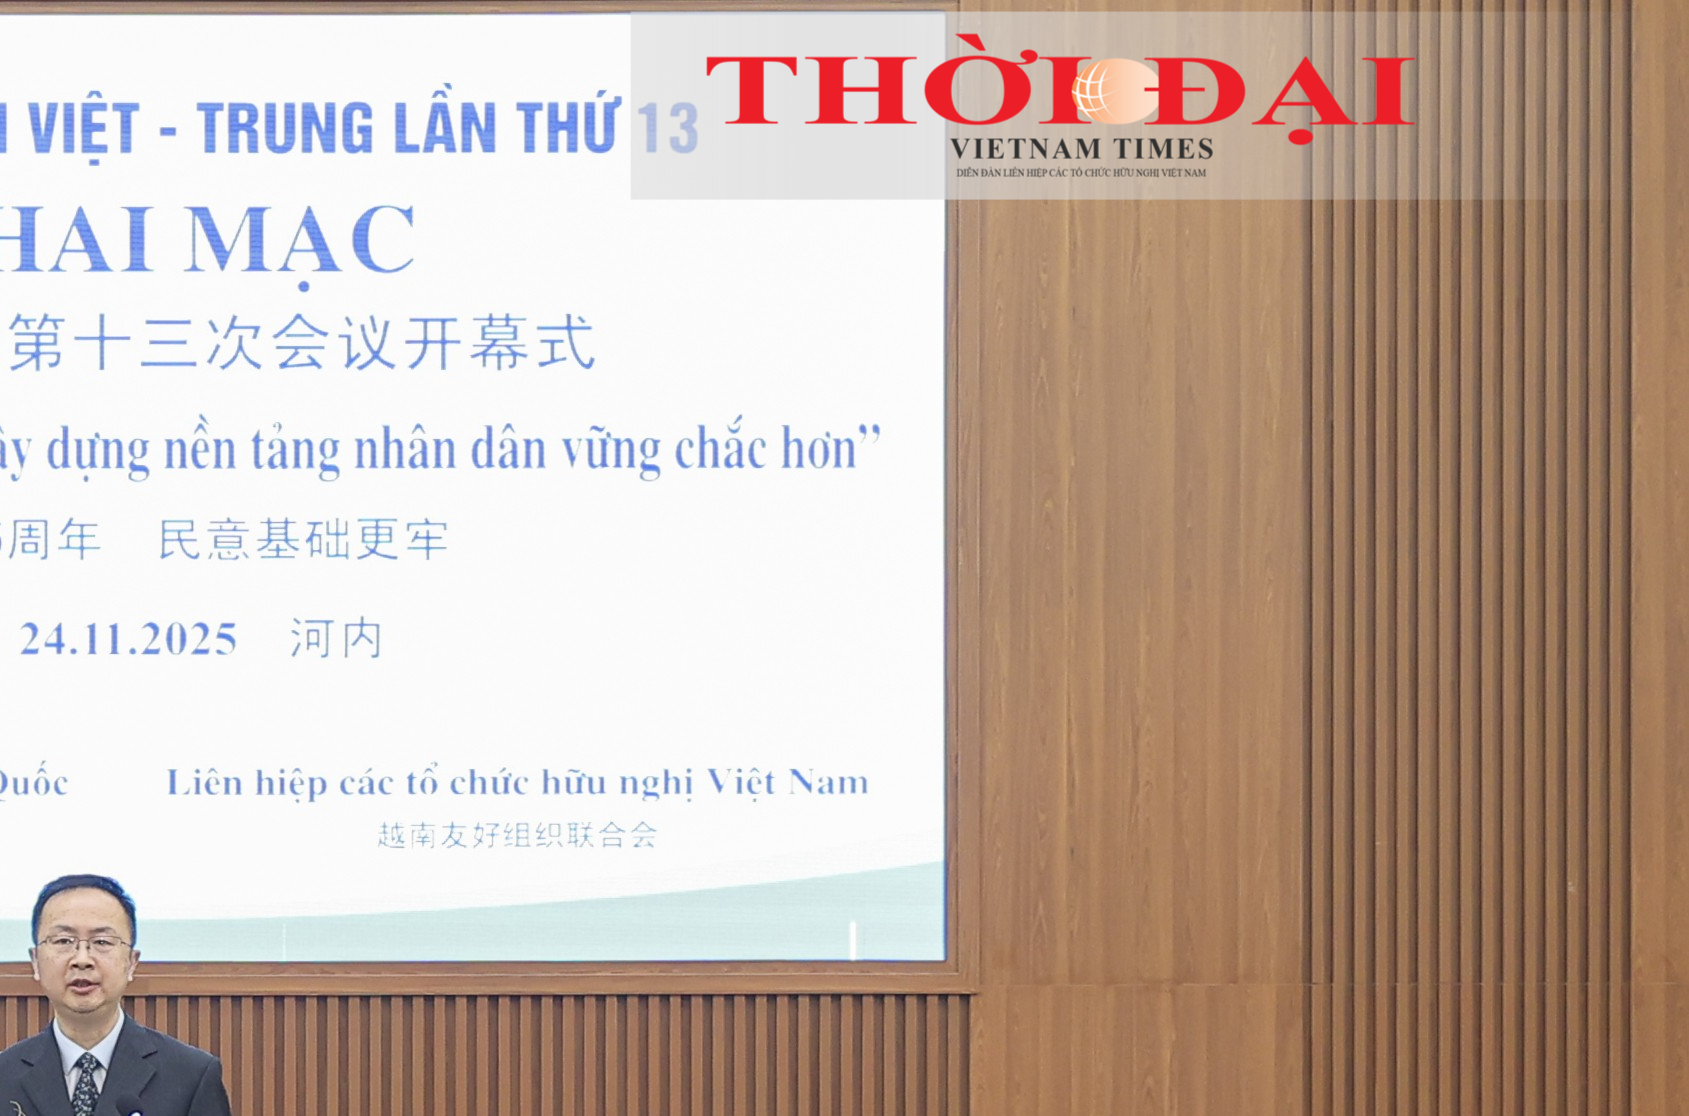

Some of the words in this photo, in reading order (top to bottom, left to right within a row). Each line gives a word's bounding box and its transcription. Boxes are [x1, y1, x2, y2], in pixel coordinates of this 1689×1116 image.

[27, 89, 141, 167] VIỆT
[159, 126, 178, 138] -
[195, 100, 374, 155] TRUNG
[394, 82, 497, 155] LẦN
[515, 89, 623, 155] THỨ
[638, 101, 699, 154] 13
[184, 204, 415, 294] MẠC
[46, 424, 151, 482] dựng
[164, 414, 236, 470] nền
[252, 421, 341, 482] tảng
[354, 422, 456, 470] nhân
[470, 422, 547, 470] dân
[561, 424, 662, 482] vững
[674, 415, 767, 470] chắc
[158, 516, 450, 562] 民意基础更牢
[19, 620, 238, 658] 24.11.2025
[289, 615, 384, 660] 河内
[166, 767, 243, 797] Liên
[254, 767, 329, 804] hiệp
[338, 767, 395, 797] các
[404, 759, 440, 797] tổ
[449, 767, 530, 797] chức
[541, 767, 607, 797] hữu
[618, 767, 694, 804] nghị
[706, 767, 777, 804] Việt
[788, 767, 870, 797] Nam
[377, 820, 659, 850] 越南友好组织联合会
